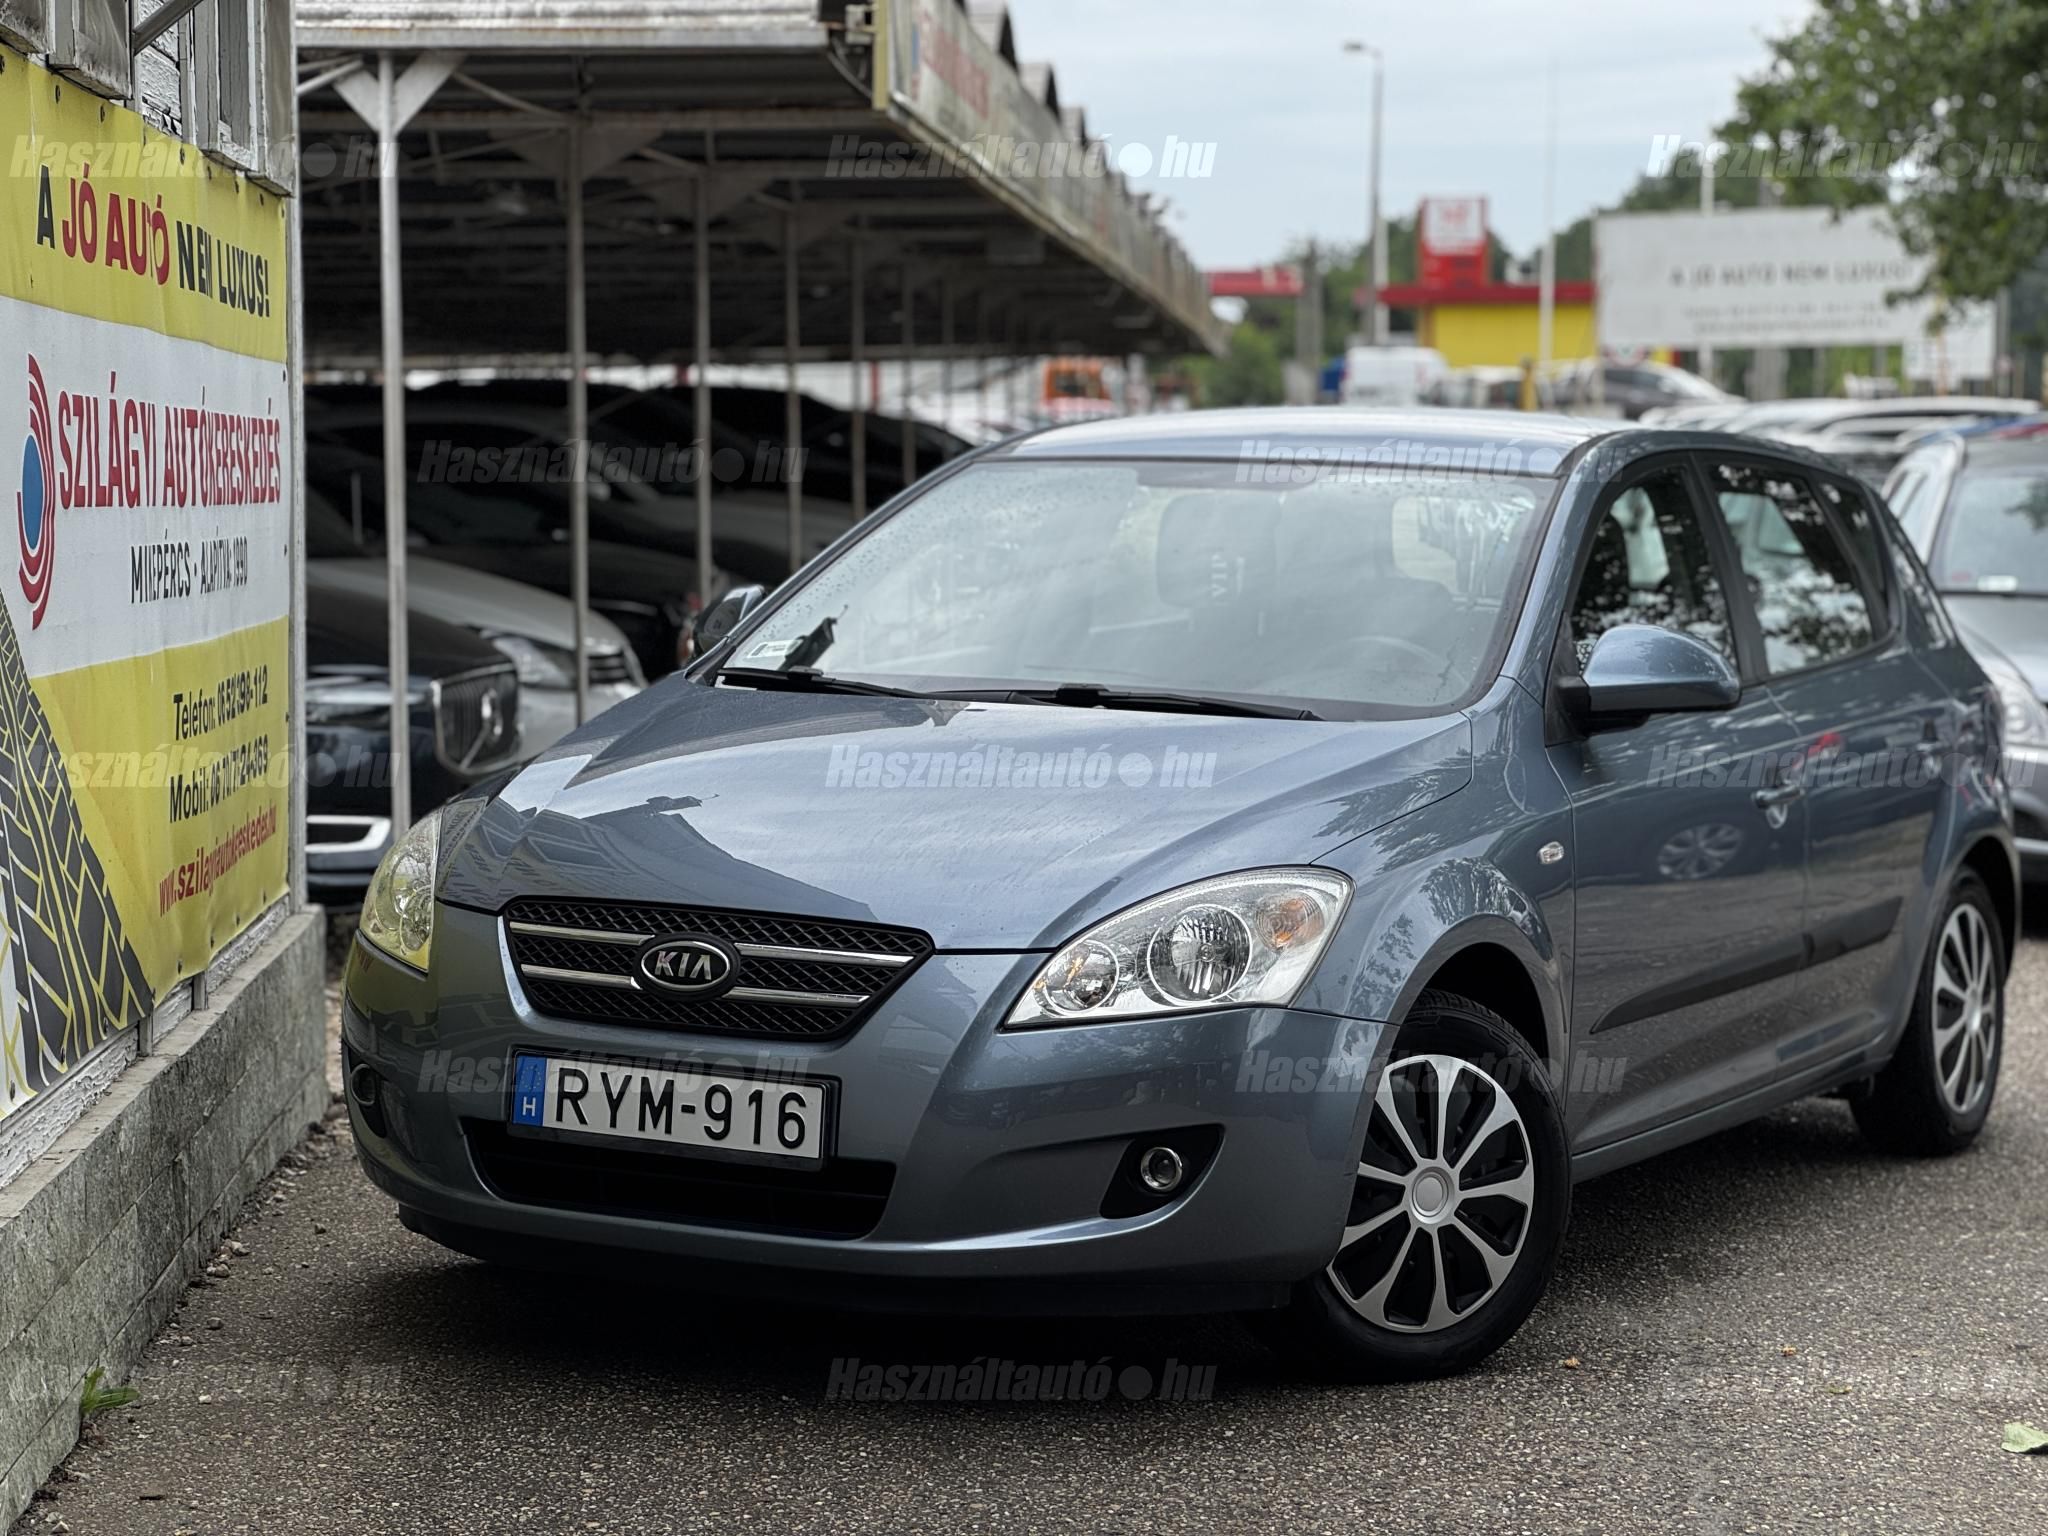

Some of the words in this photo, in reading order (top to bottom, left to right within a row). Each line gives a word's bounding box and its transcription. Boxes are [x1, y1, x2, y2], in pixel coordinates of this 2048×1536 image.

[36, 164, 56, 250] A
[62, 162, 98, 264] JÓ
[105, 194, 171, 286] AUTÓ
[176, 220, 213, 299] NEM
[216, 239, 270, 318] LUXUS!
[58, 371, 157, 510] SZILÁGYI
[163, 386, 281, 508] AUTÓKERESKEDÉS
[233, 536, 249, 588] 1990
[173, 688, 216, 741] Telefon:
[170, 767, 209, 823] Mobil:
[655, 949, 712, 981] KIA
[522, 1098, 536, 1118] H
[555, 1067, 808, 1150] RYM-916
